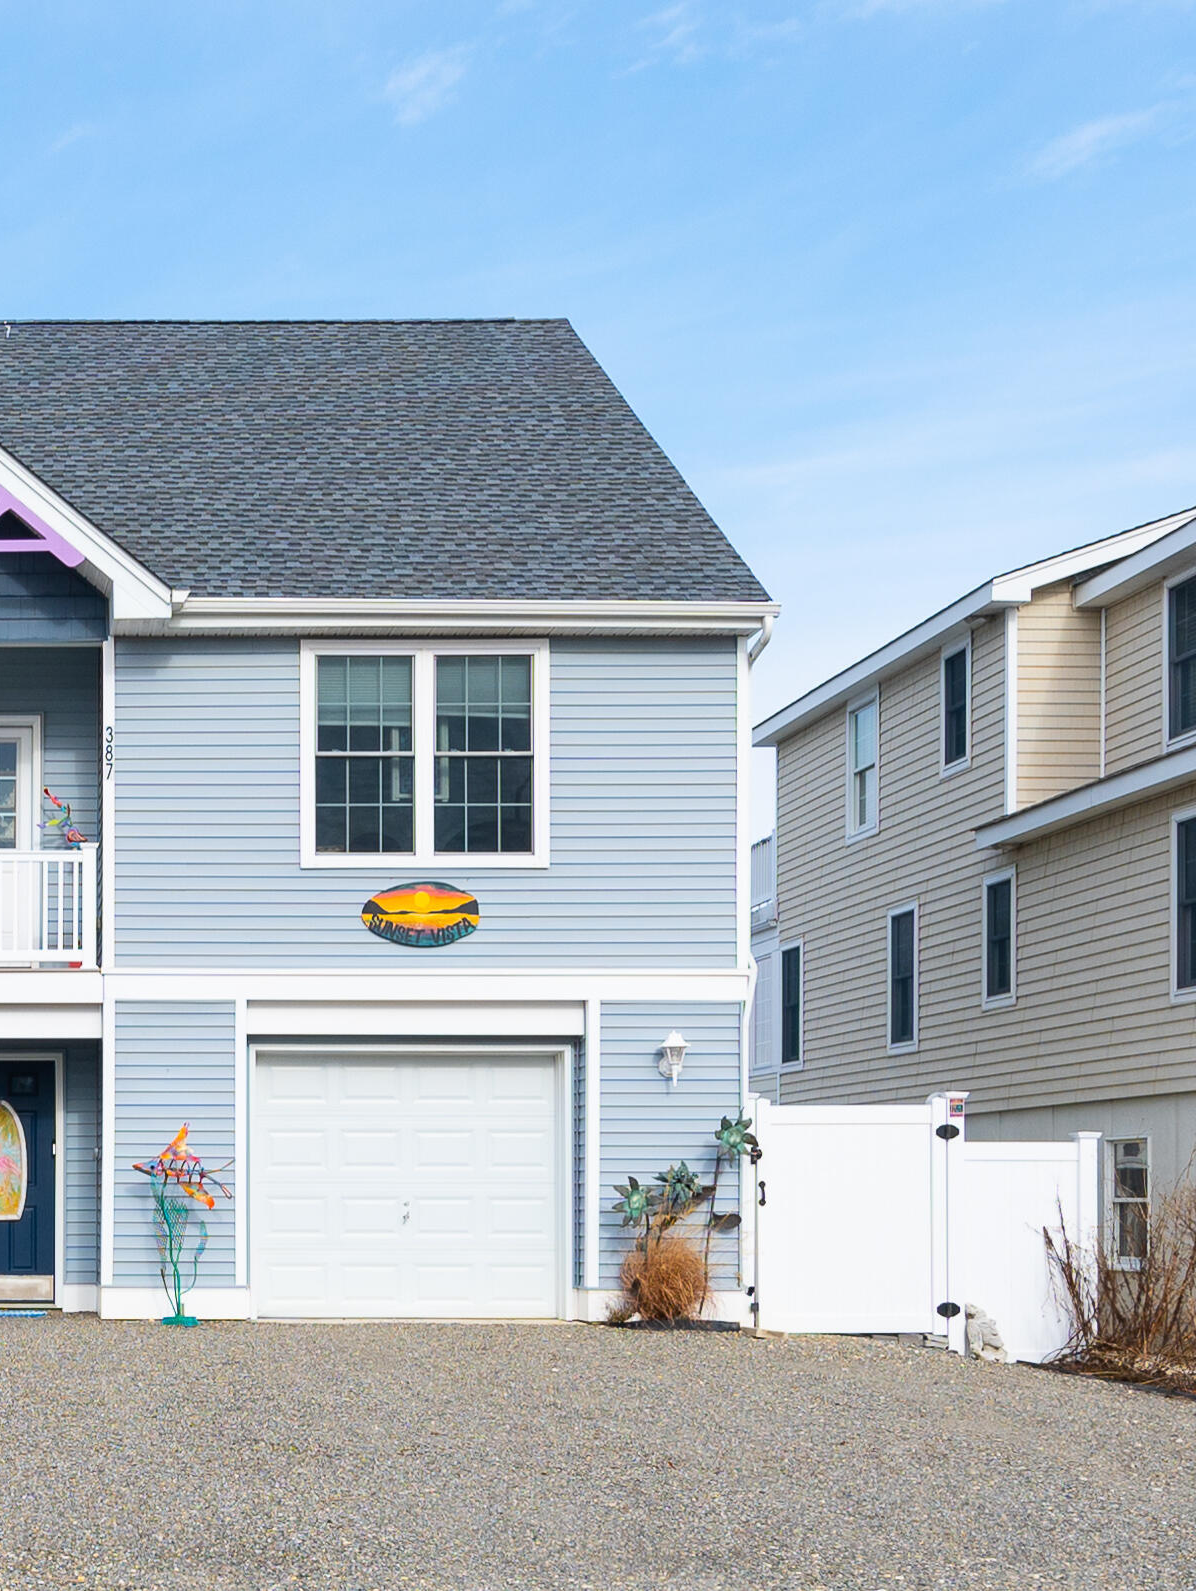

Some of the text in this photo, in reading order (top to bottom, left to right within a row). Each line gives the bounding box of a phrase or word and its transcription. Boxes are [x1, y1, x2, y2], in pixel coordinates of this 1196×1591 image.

[105, 726, 113, 780] 387
[368, 914, 476, 944] SUNSET VISTA
